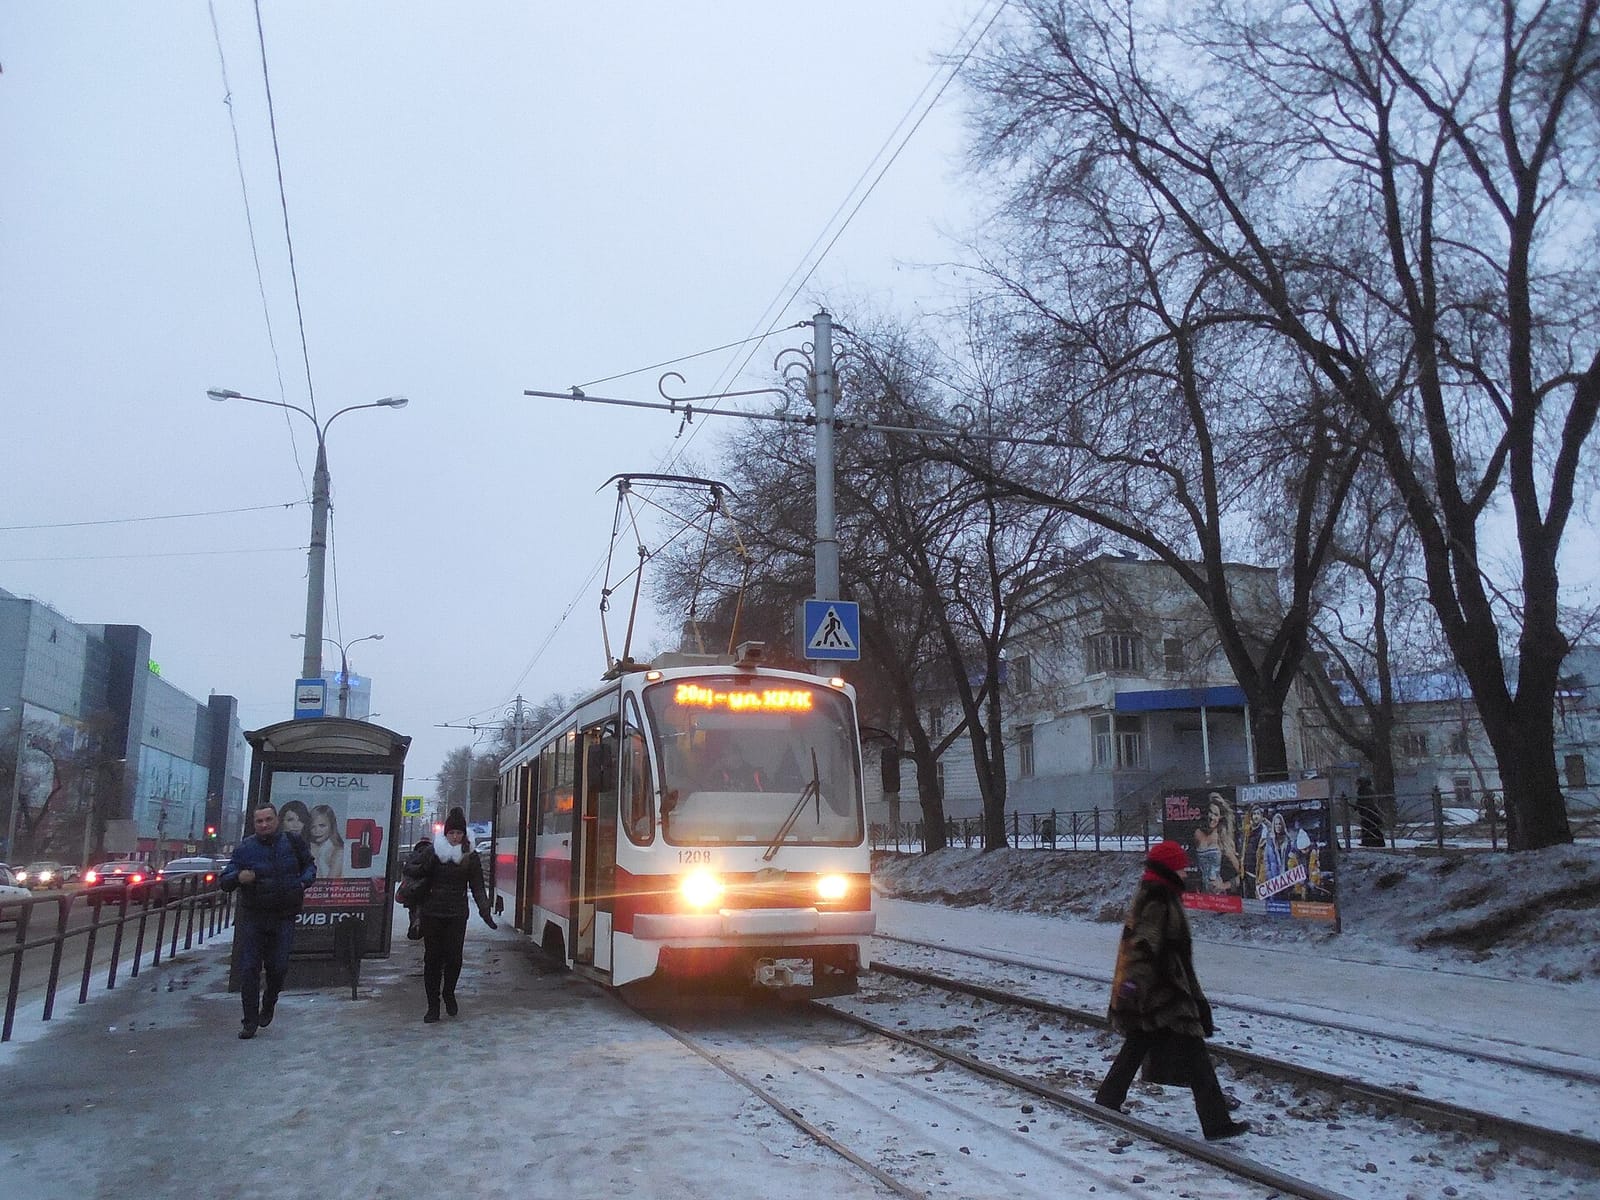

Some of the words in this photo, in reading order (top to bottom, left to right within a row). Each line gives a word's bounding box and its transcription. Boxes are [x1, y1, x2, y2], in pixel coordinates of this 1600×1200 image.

[1242, 783, 1298, 802] DIDRIKSONS
[678, 850, 711, 864] 1208
[1258, 866, 1306, 897] СКИДКИ!
